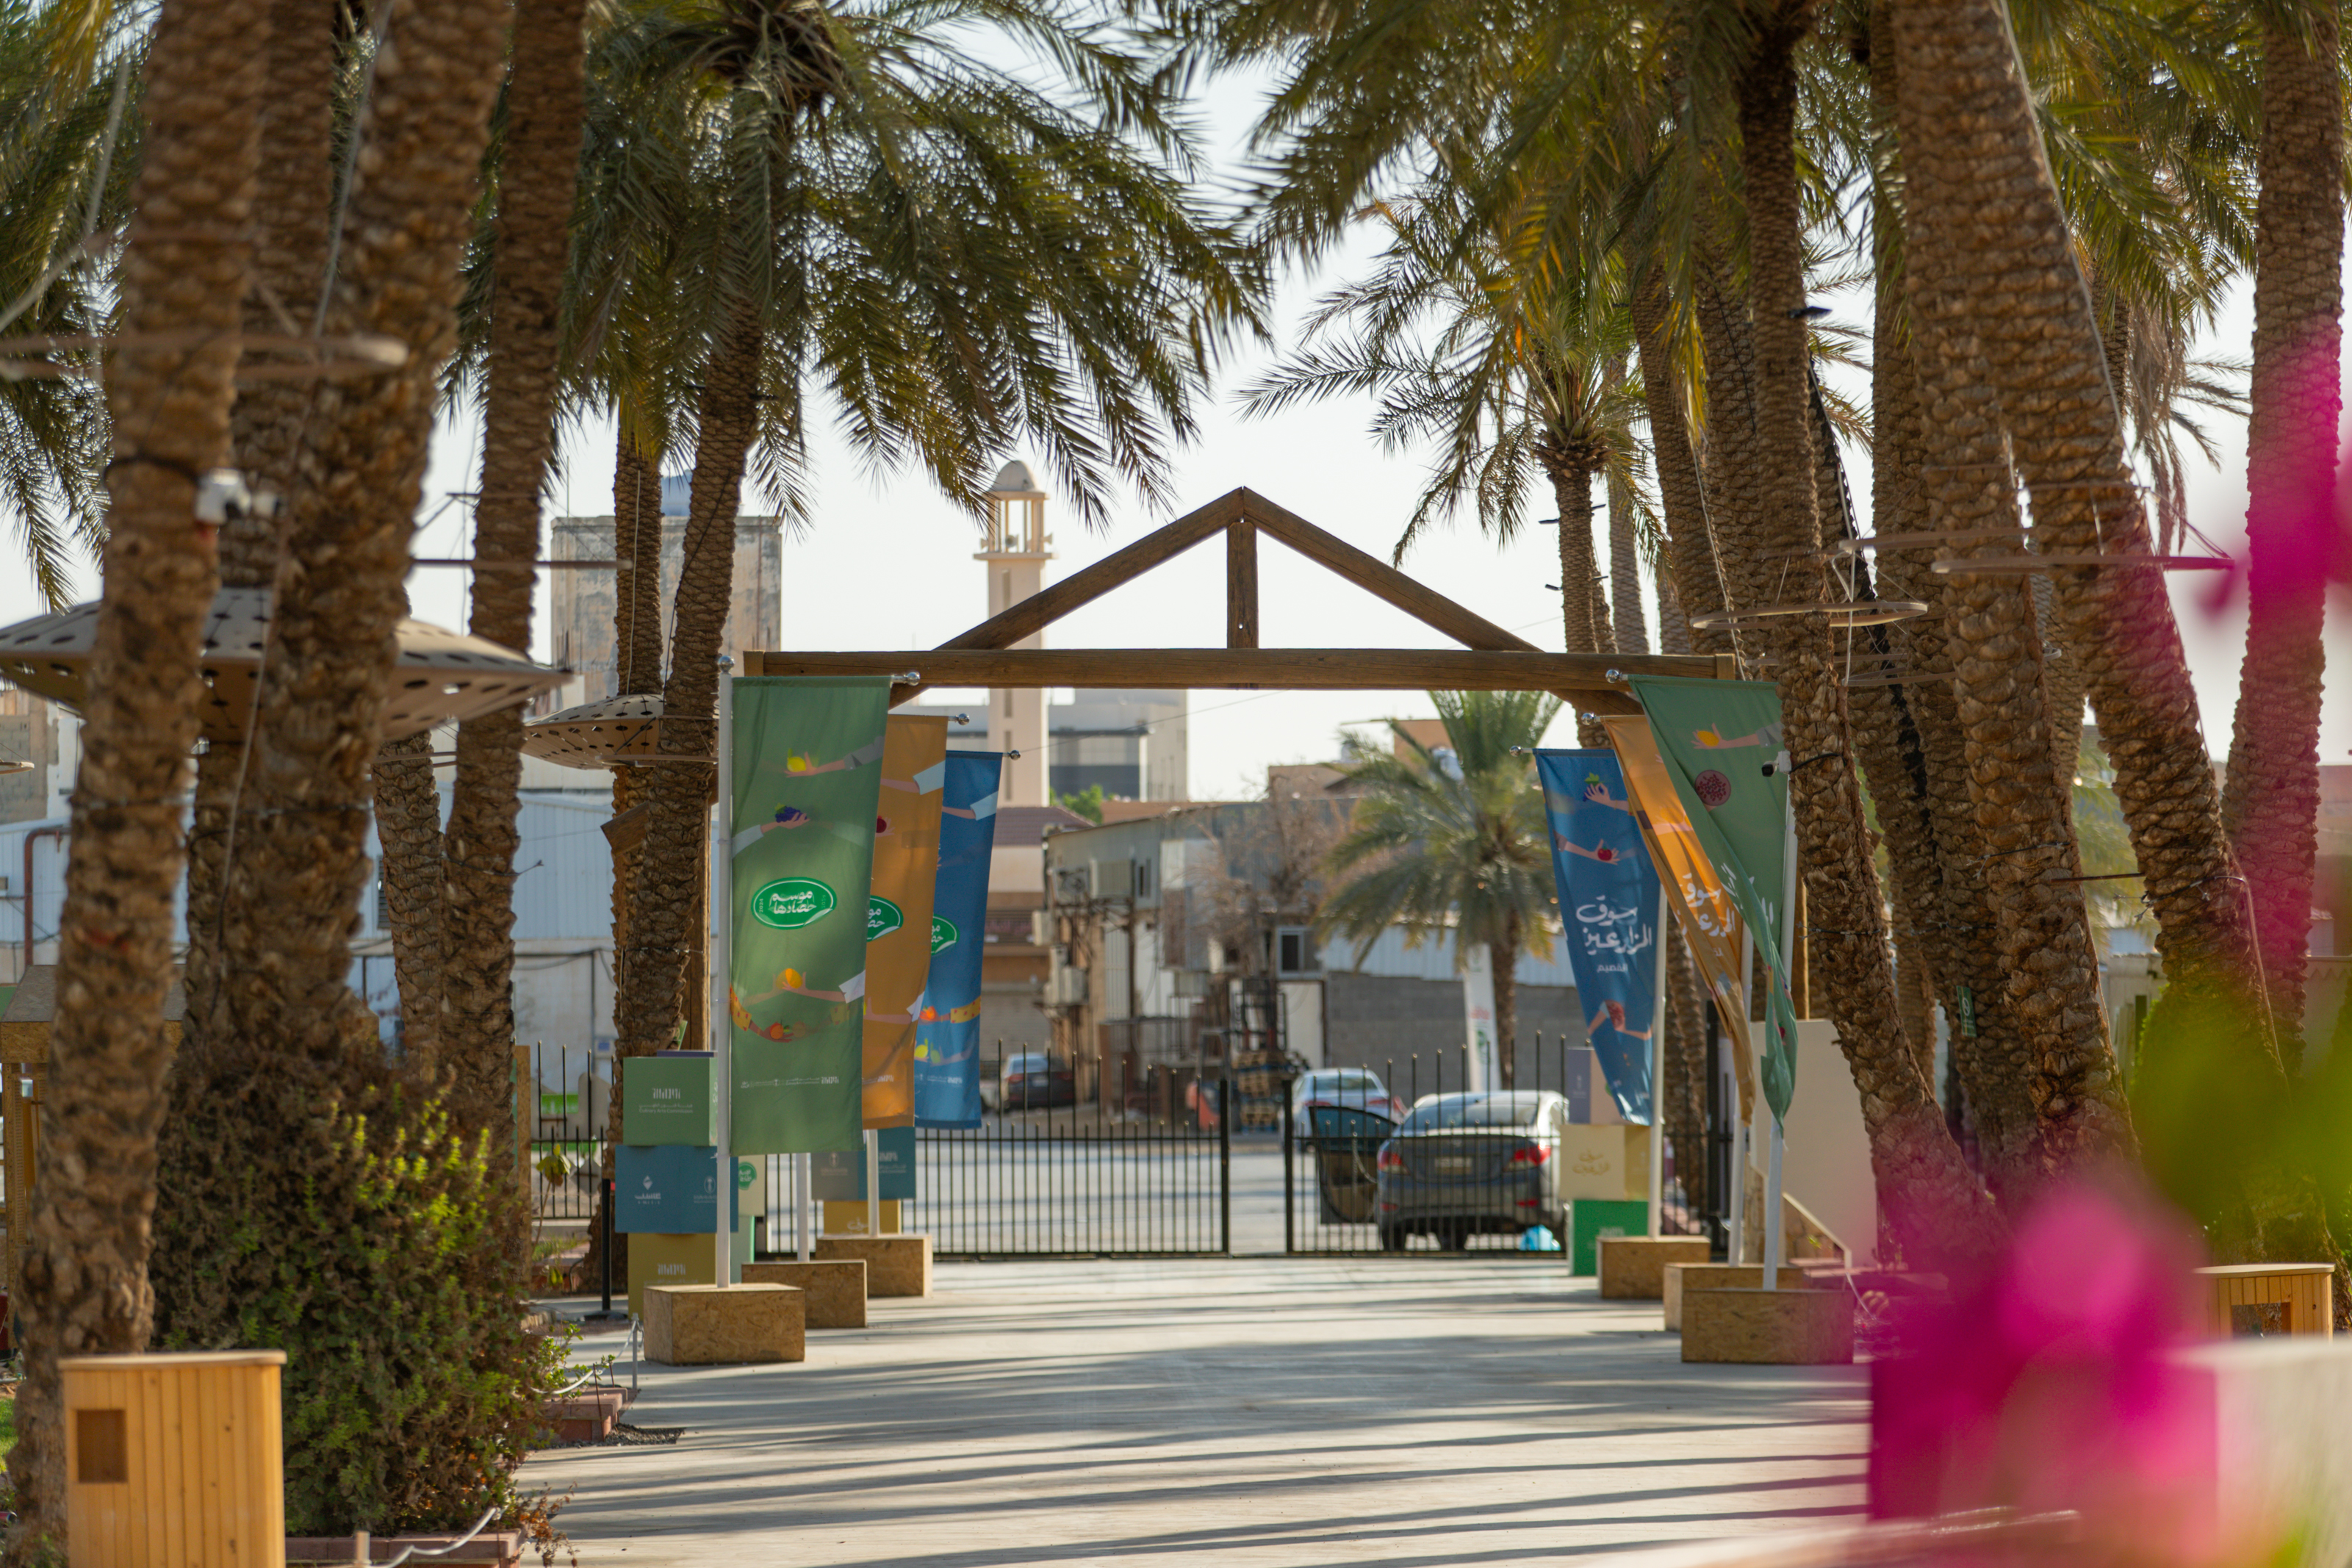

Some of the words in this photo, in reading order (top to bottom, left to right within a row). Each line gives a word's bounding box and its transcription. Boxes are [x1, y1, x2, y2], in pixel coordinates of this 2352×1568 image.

[769, 891, 813, 907] موسم
[774, 899, 817, 914] حصادها
[1576, 895, 1638, 926] سوق
[1583, 923, 1652, 955] المزارعين
